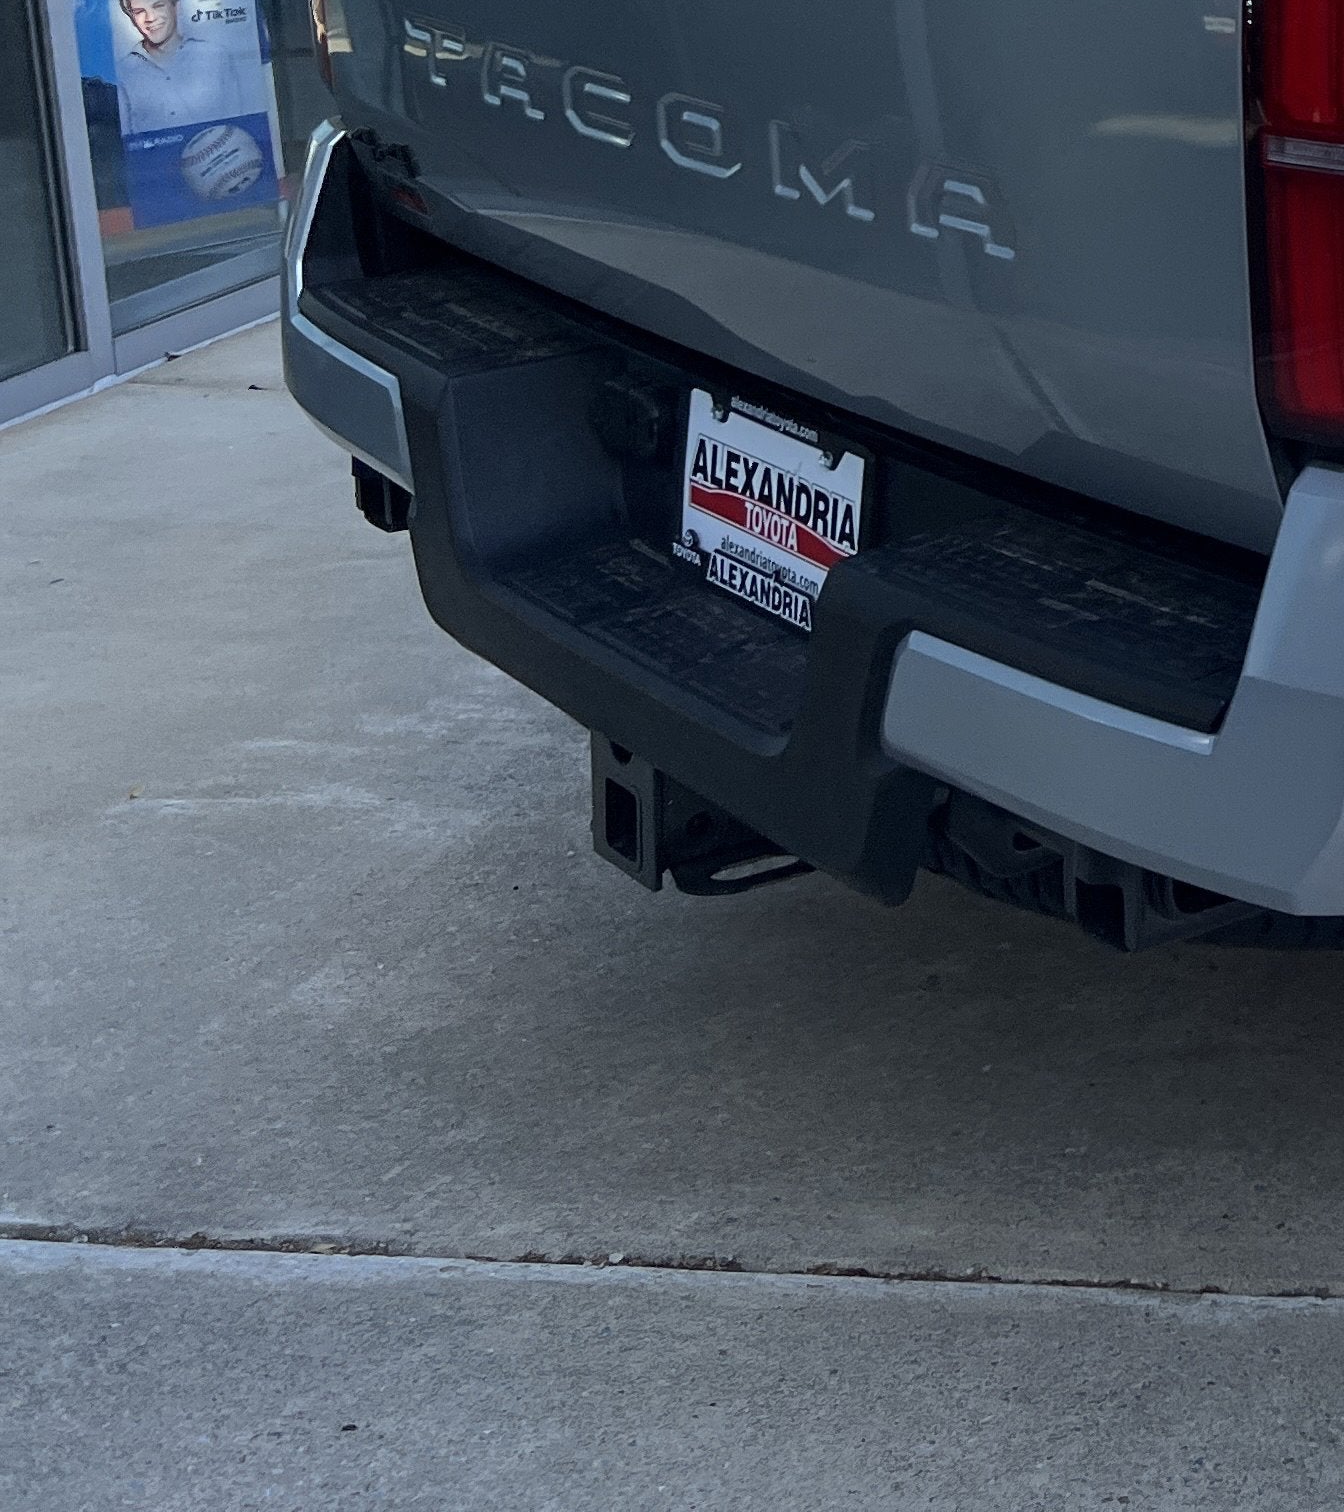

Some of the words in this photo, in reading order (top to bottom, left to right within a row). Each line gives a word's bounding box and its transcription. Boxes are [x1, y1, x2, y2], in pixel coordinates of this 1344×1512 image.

[403, 10, 1017, 261] TACOMA
[691, 438, 857, 554] ALEXANDRIA
[744, 502, 798, 552] TOYOTA
[672, 541, 702, 567] TOYOTA
[707, 553, 812, 631] ALEXANDRIA
